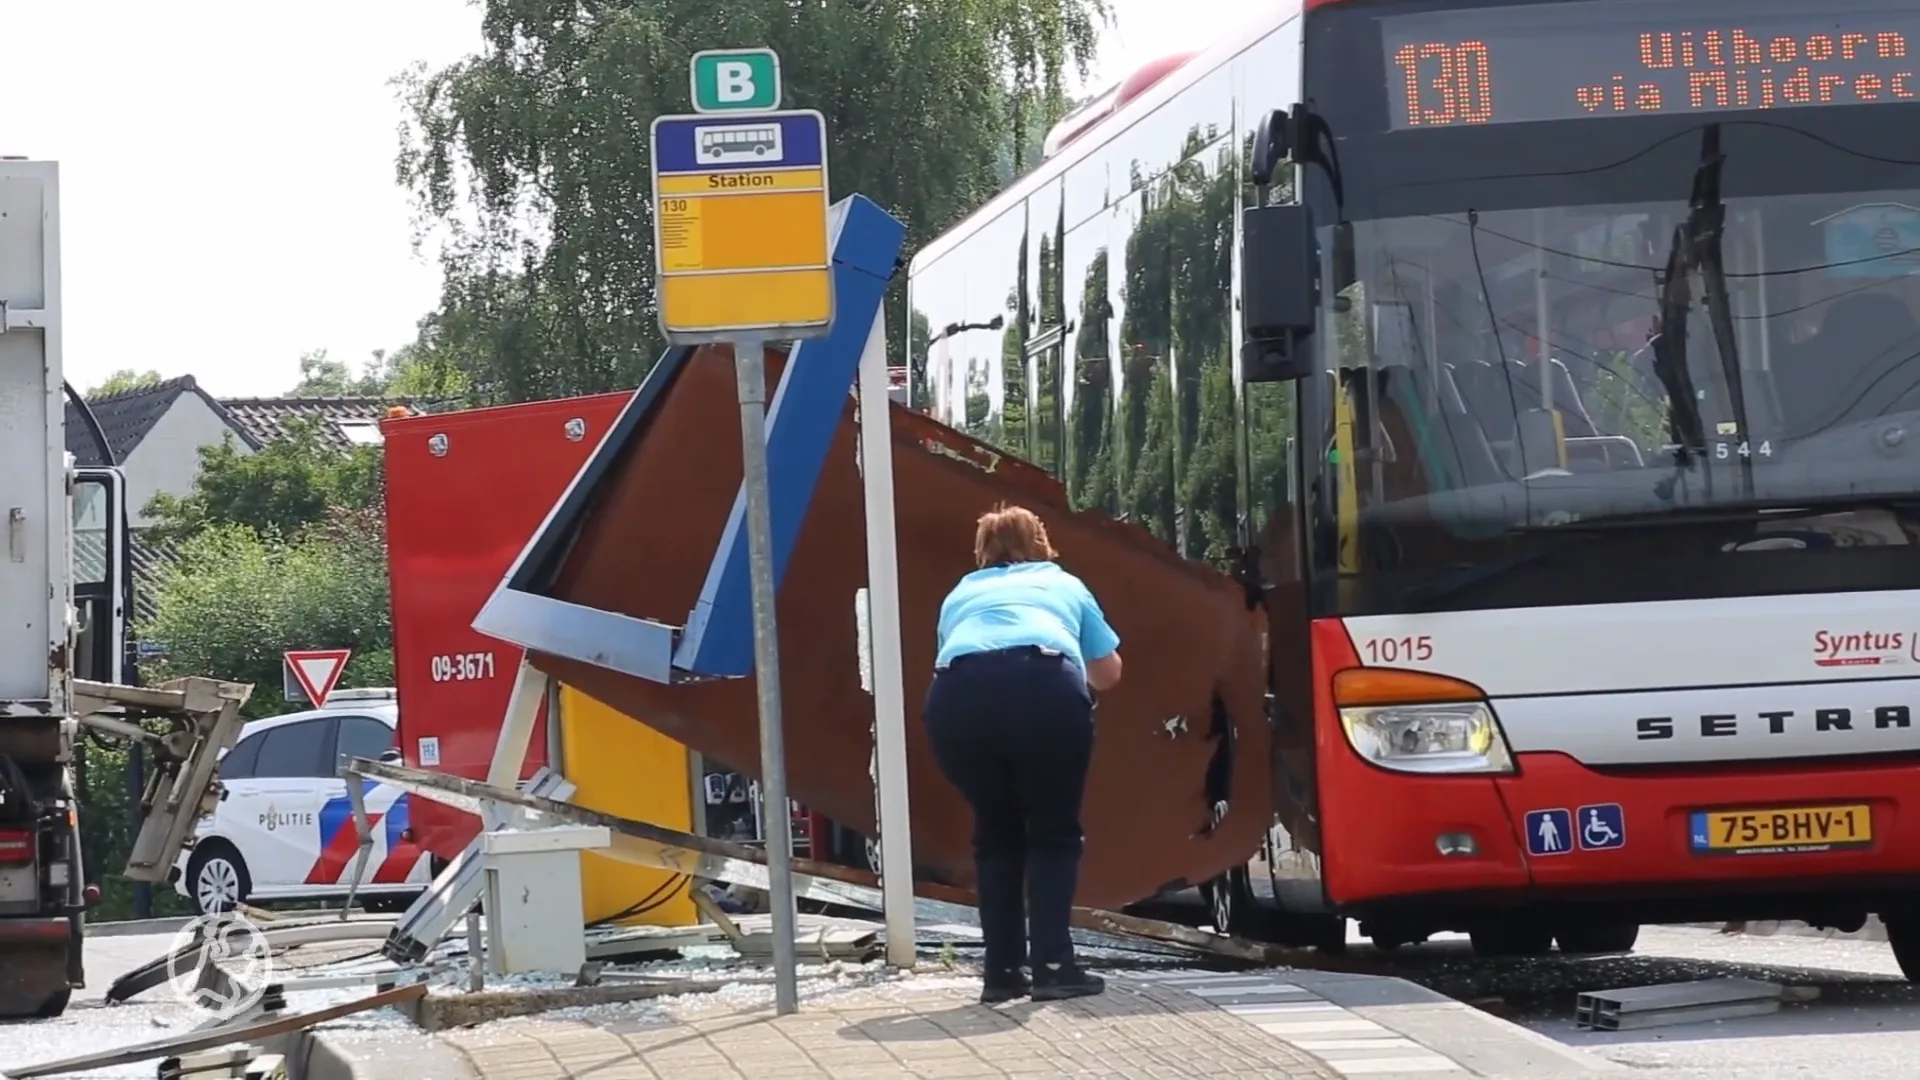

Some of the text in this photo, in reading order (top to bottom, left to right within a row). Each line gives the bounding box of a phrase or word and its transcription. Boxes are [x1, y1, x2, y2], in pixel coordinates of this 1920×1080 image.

[1640, 29, 1906, 68] Uithoorn
[716, 61, 756, 103] B
[1394, 40, 1491, 125] 130
[1576, 66, 1915, 112] via Mijdrec
[708, 173, 775, 189] Station
[662, 199, 688, 213] 130
[1366, 635, 1433, 663] 1015
[1814, 630, 1903, 658] Syntus
[431, 652, 494, 682] 09-3671
[1636, 705, 1911, 740] SETRA
[1693, 835, 1707, 844] NL
[1720, 810, 1855, 844] 75-BHV-1
